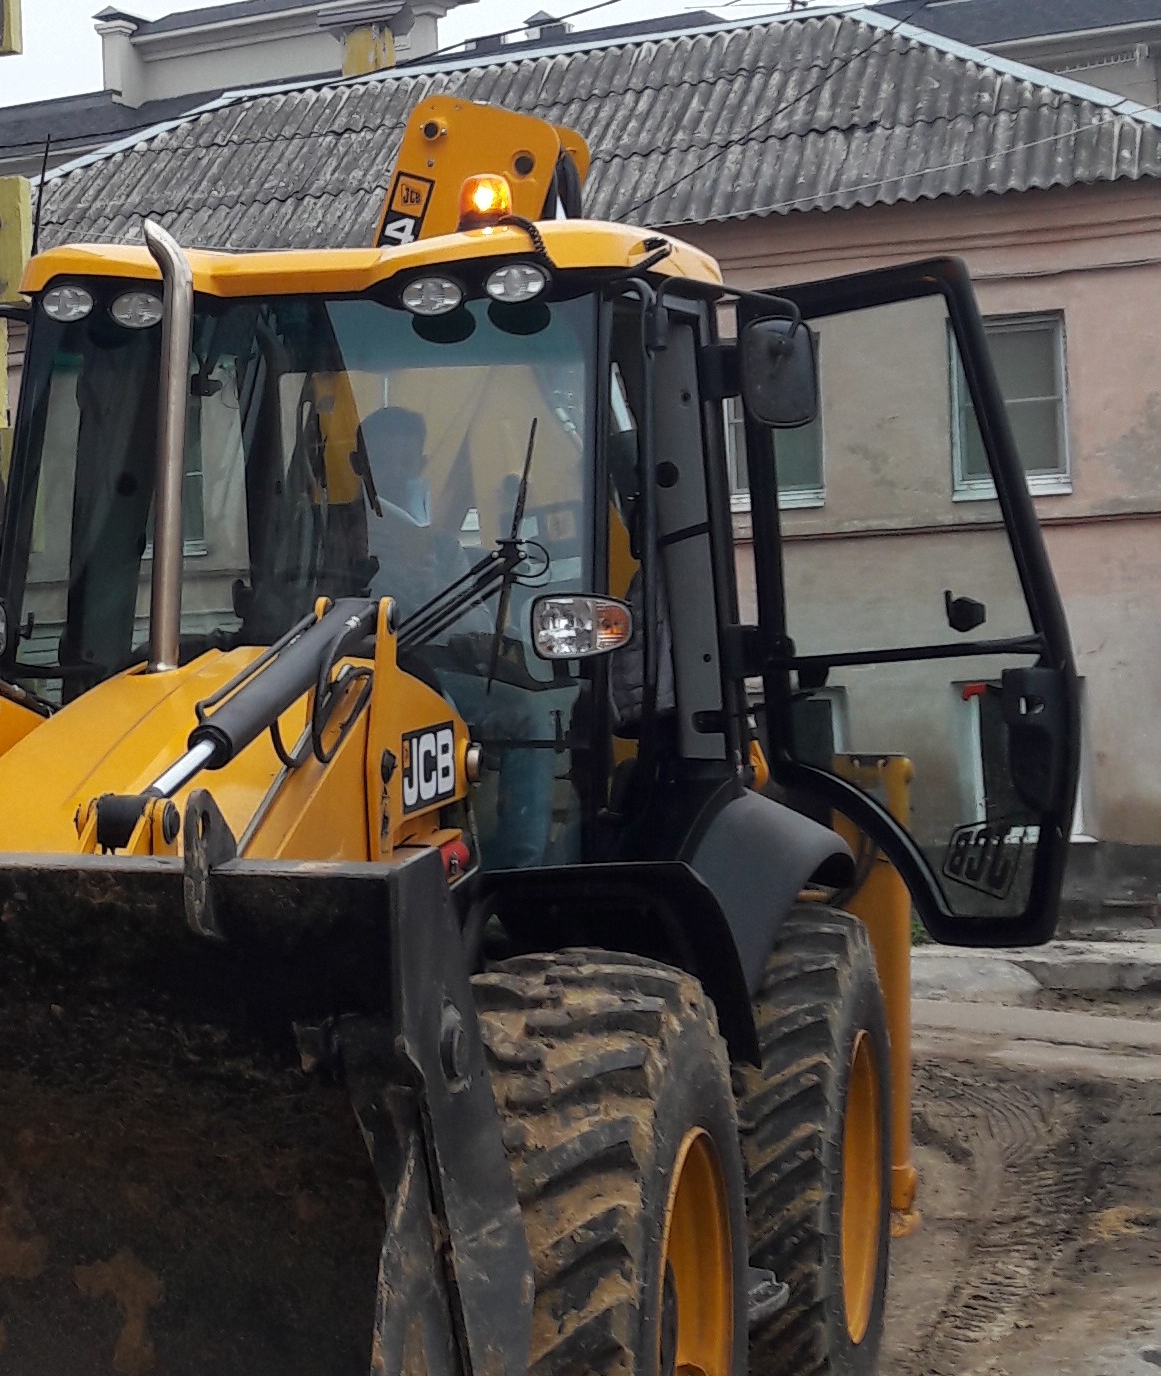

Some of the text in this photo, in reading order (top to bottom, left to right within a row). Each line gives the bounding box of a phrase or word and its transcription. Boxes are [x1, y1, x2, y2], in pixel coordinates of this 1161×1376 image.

[402, 186, 421, 204] JCB
[381, 217, 415, 247] 4
[403, 728, 455, 806] JCB
